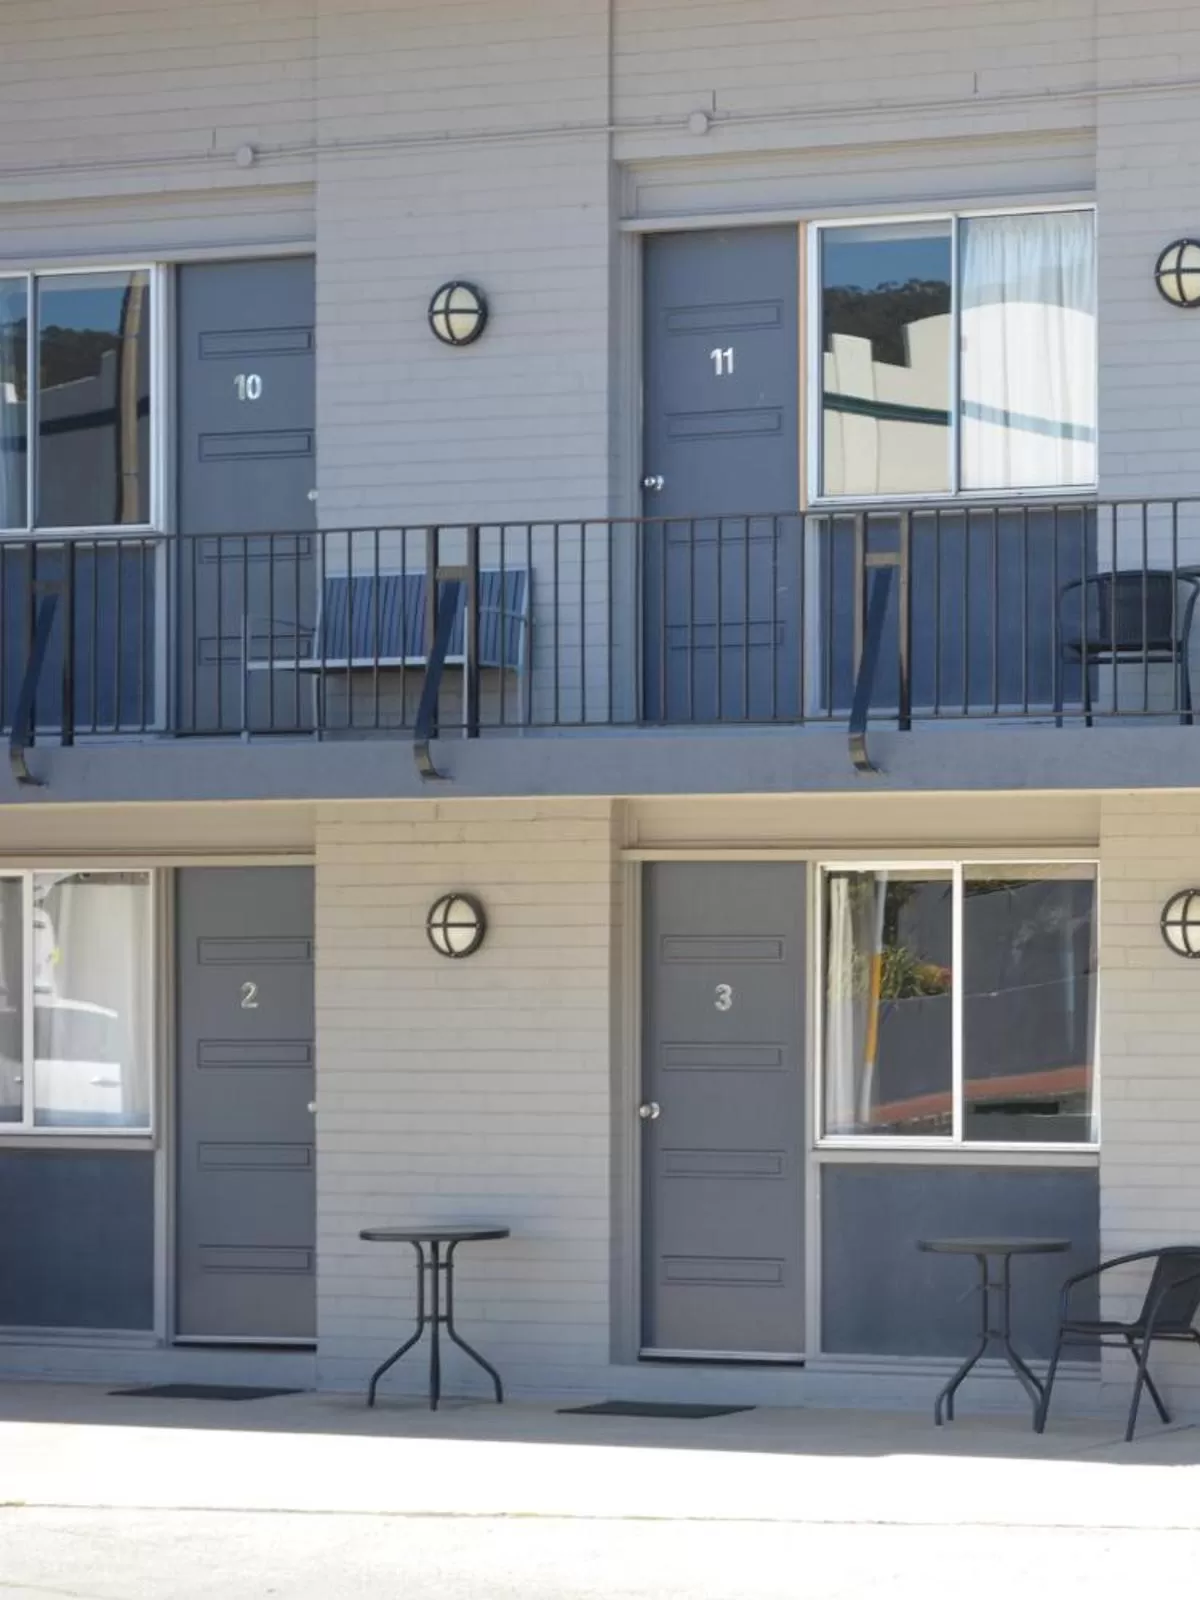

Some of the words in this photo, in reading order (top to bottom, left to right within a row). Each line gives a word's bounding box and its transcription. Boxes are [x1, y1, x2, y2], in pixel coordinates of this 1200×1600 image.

[710, 347, 734, 376] 11
[233, 373, 263, 401] 10
[240, 981, 259, 1009] 2
[714, 983, 733, 1011] 3
